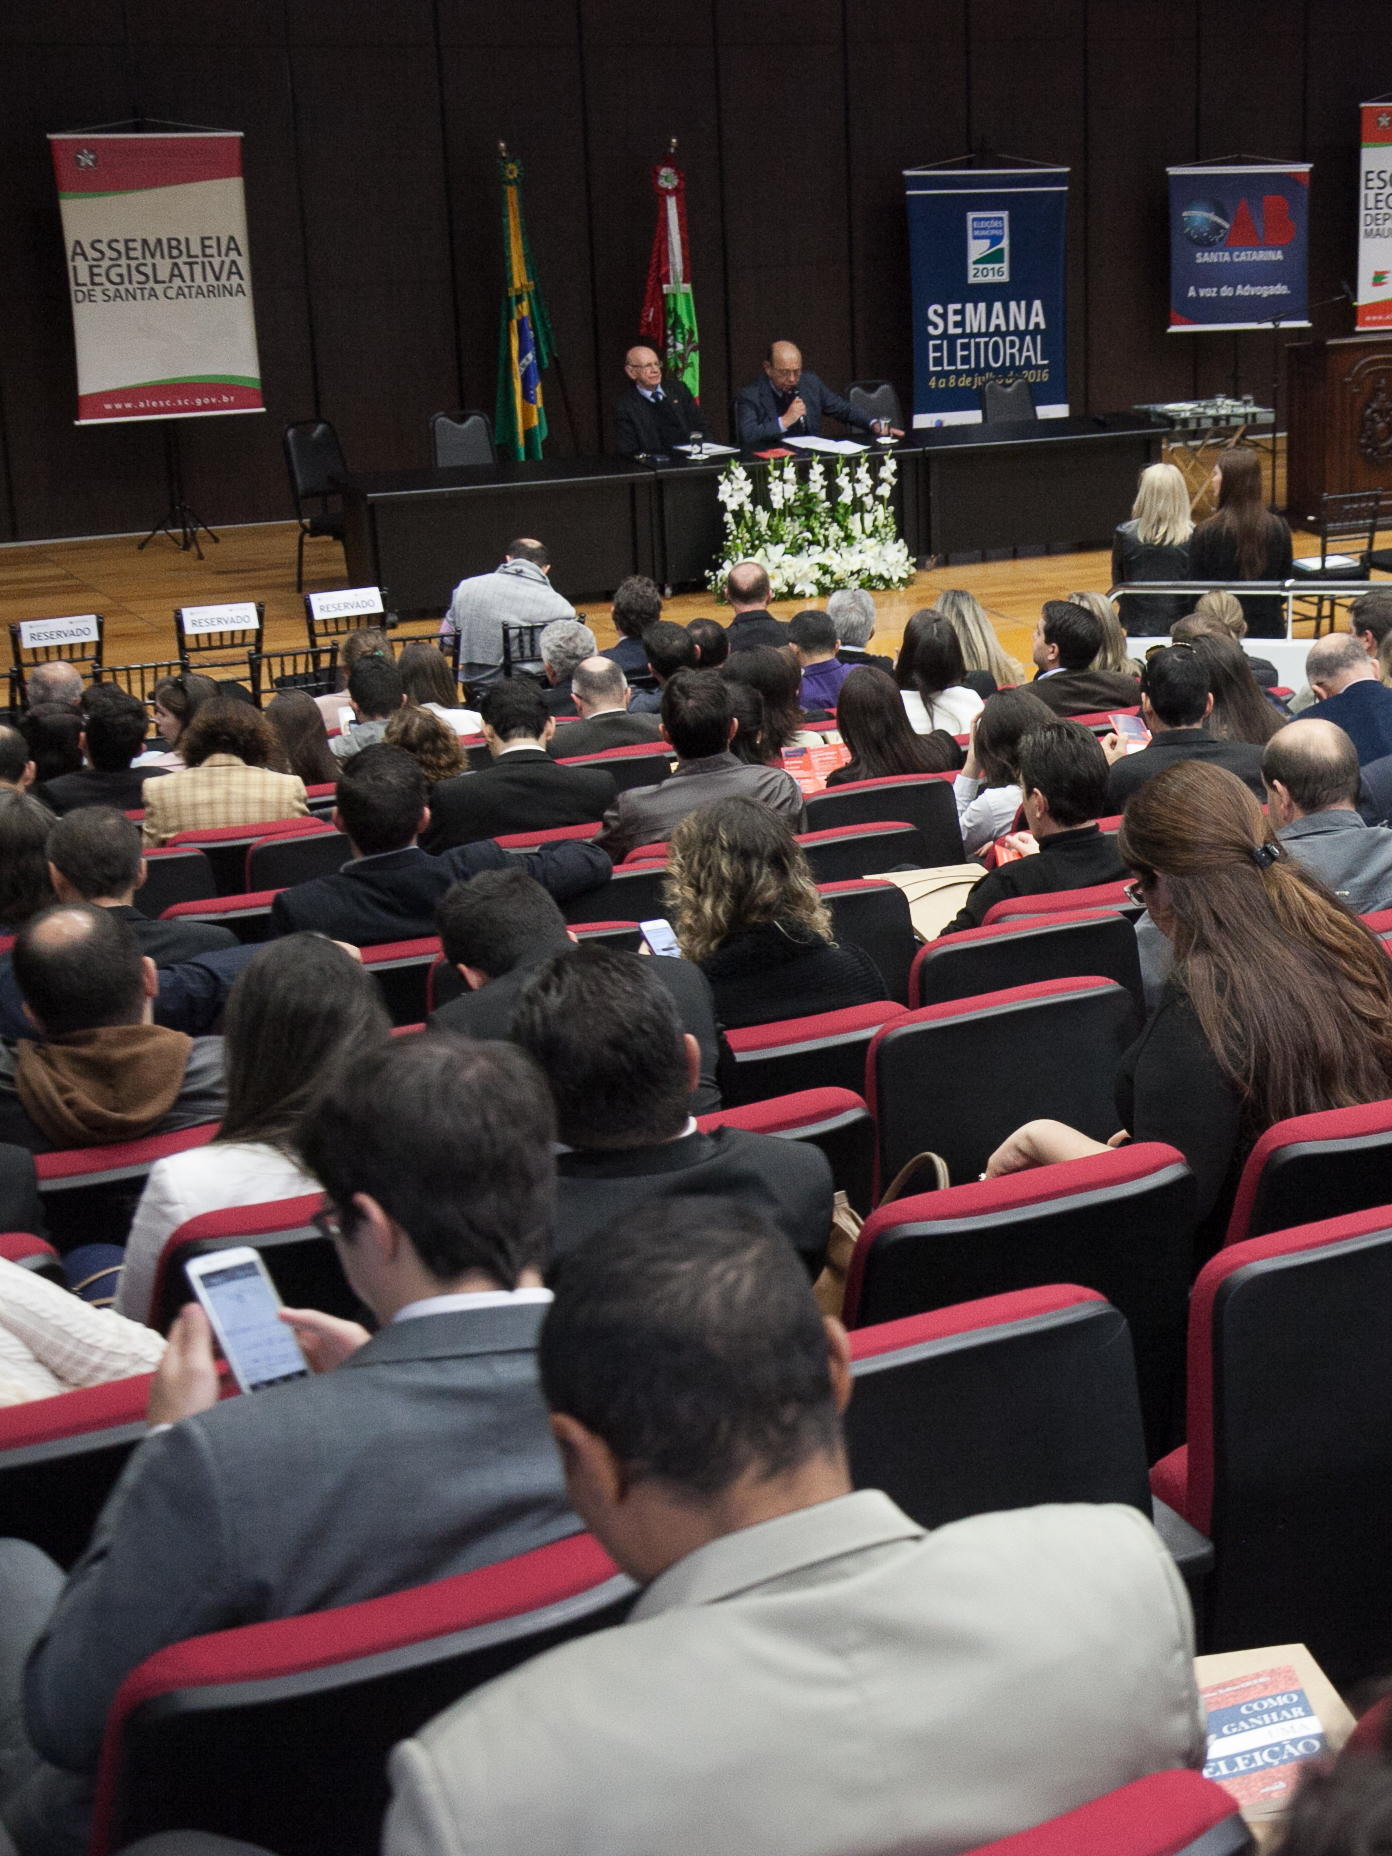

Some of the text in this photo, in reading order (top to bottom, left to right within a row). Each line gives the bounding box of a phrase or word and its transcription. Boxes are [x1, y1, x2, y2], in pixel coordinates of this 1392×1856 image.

[70, 235, 243, 263] ASSEMBLEIA
[1195, 250, 1284, 263] SANTA CATARINA
[71, 259, 245, 287] LEGISLATIVA
[972, 266, 1005, 278] 2016
[73, 282, 247, 304] DE SANTA CATARINA
[1187, 283, 1291, 298] A voz do Advogado.
[927, 300, 1047, 336] SEMANA
[928, 335, 1049, 372] ELEITORAL
[928, 376, 936, 389] 4
[938, 377, 946, 389] a
[948, 375, 956, 387] 8
[957, 373, 972, 387] de
[103, 394, 236, 410] www.alesc.sc.gov.br
[319, 599, 375, 613] RESERVADO
[190, 615, 251, 628] RESERVADO
[29, 627, 92, 641] RESERVADO
[1240, 1693, 1299, 1715] COMO
[1221, 1706, 1306, 1735] GANHAR
[1267, 1722, 1310, 1739] UMA
[1202, 1738, 1321, 1778] ELEIÇÃO
